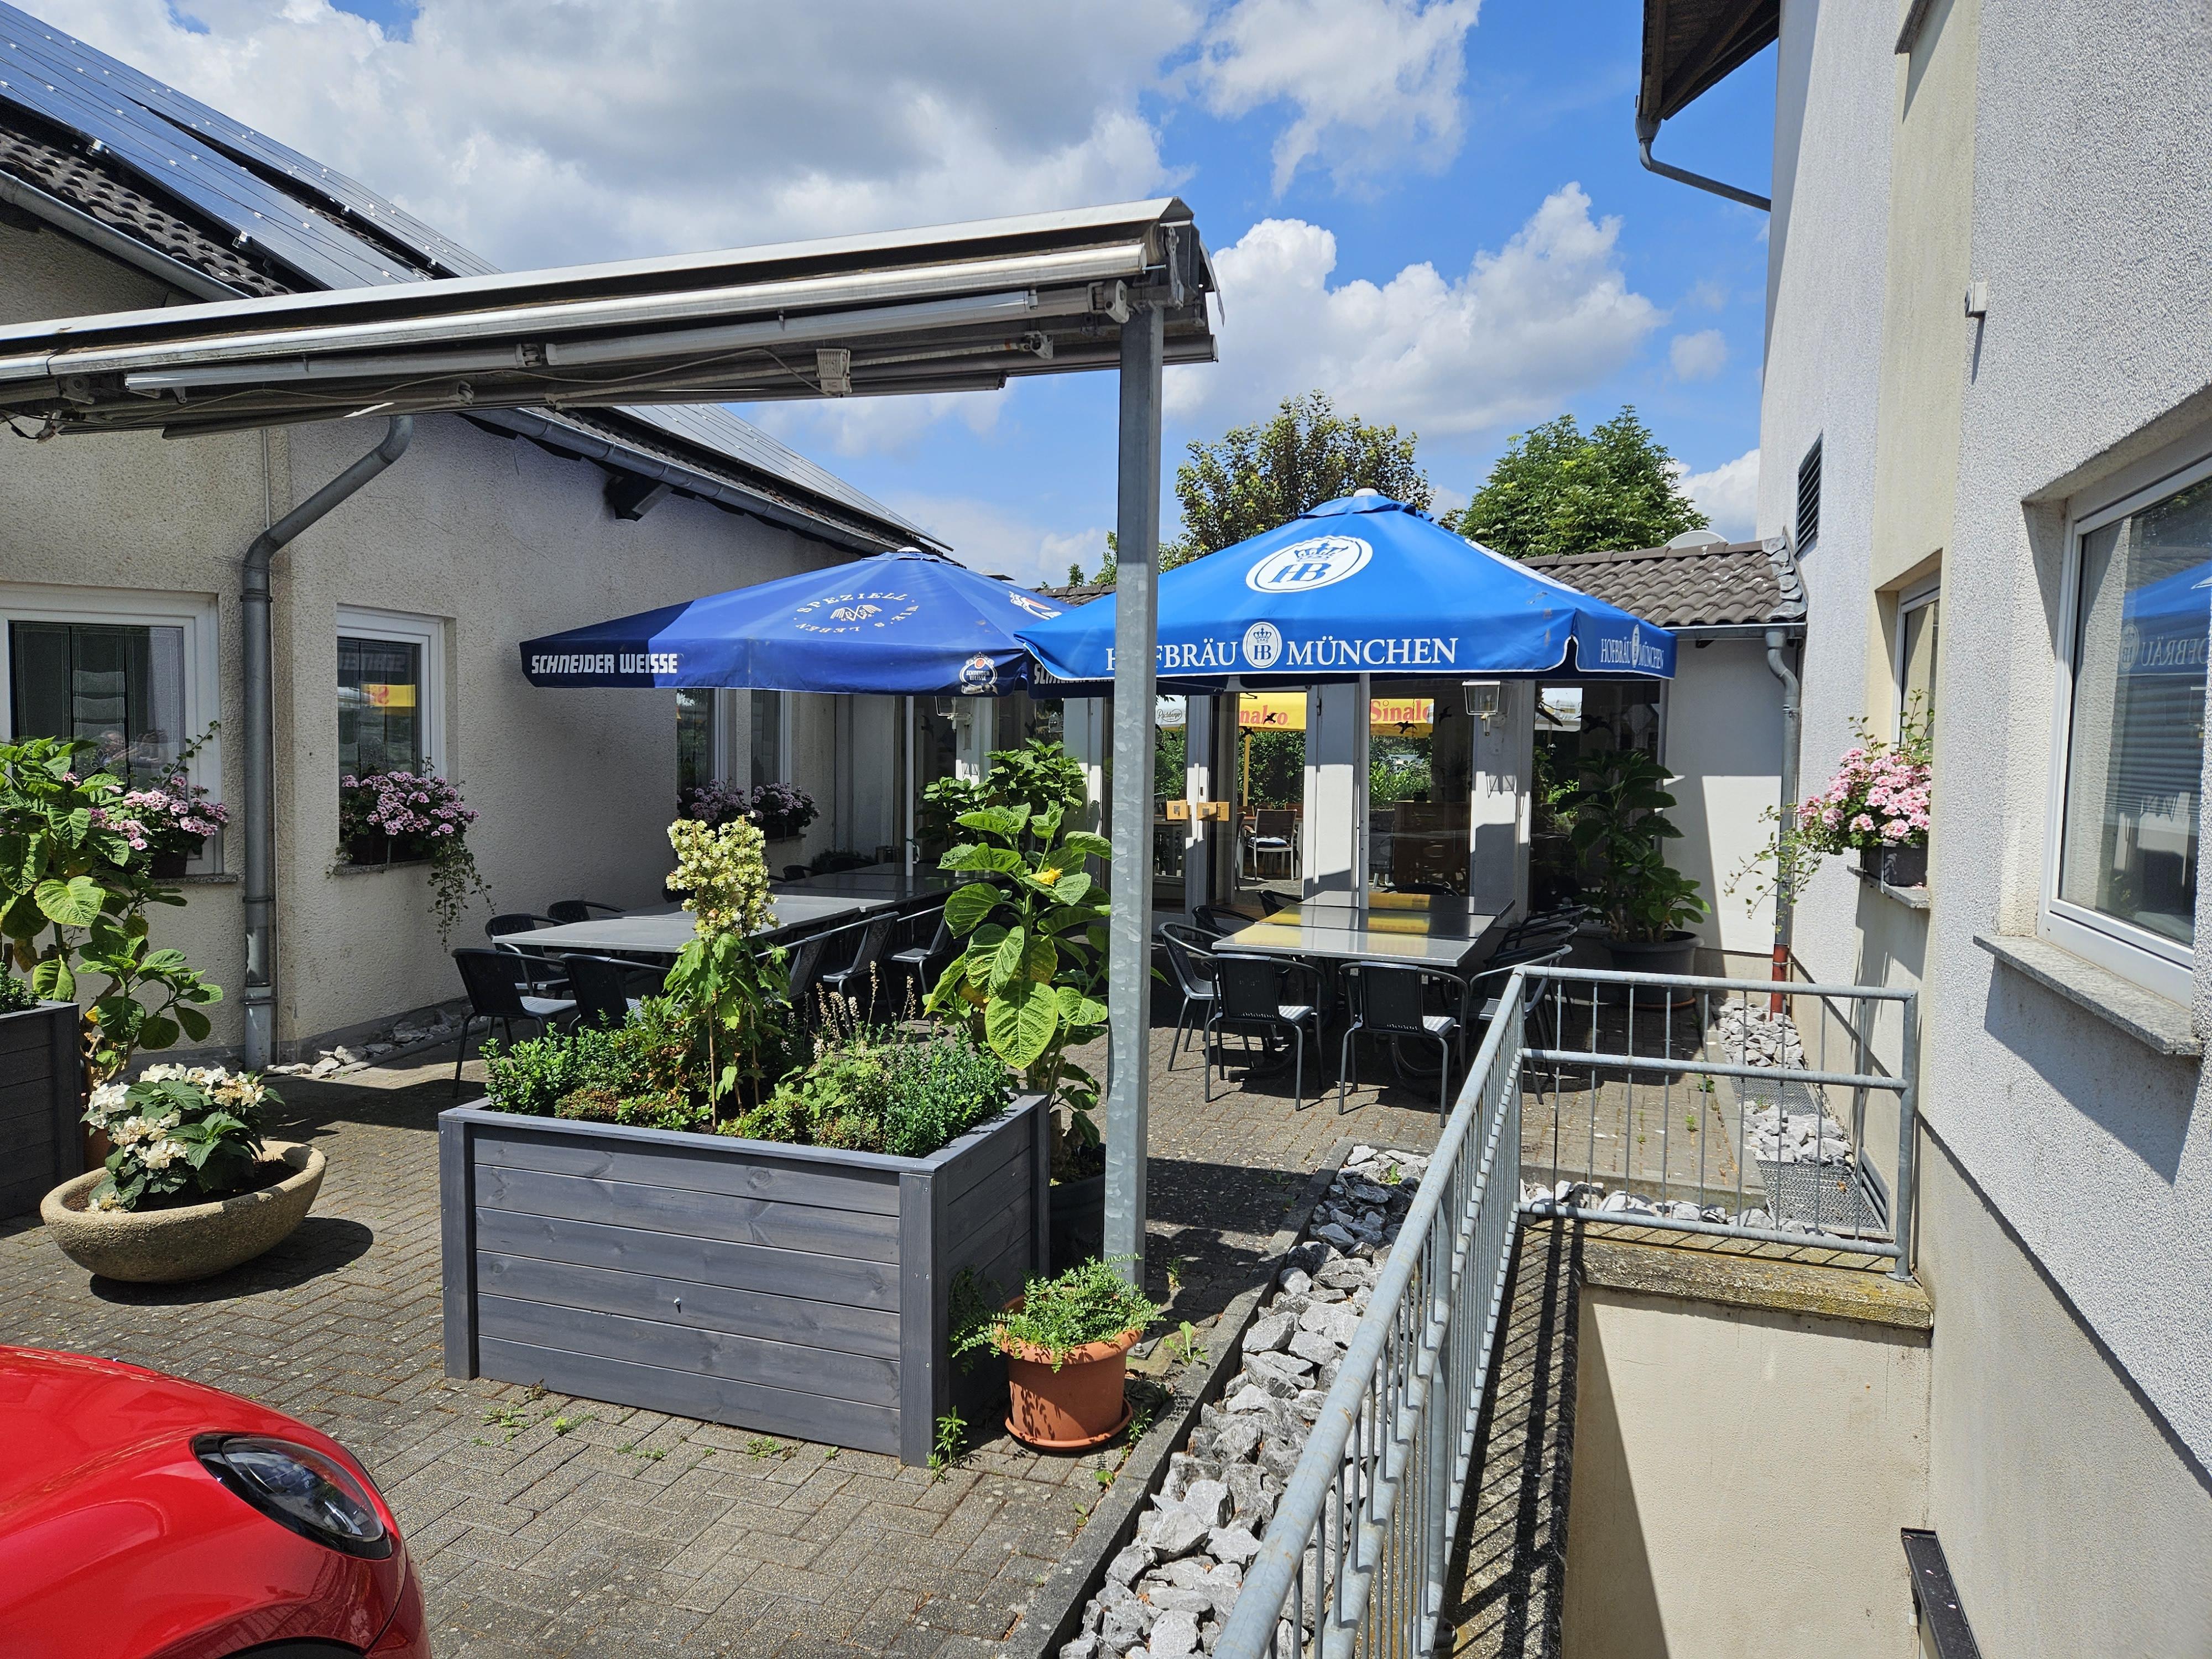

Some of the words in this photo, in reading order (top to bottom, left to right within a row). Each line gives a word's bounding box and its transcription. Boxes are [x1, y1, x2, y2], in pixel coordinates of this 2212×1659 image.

[1267, 563, 1332, 583] HB
[797, 592, 907, 613] SPEZIELL
[1106, 638, 1238, 670] BRÄU
[1254, 645, 1271, 660] HB
[1286, 635, 1458, 665] MÜNCHEN
[1600, 637, 1631, 663] HOFBRÄU
[1638, 641, 1663, 670] MÜNCHEN
[531, 655, 614, 674] SCHNEIDER
[619, 654, 677, 673] WEISSE
[1371, 699, 1430, 721] Sinal
